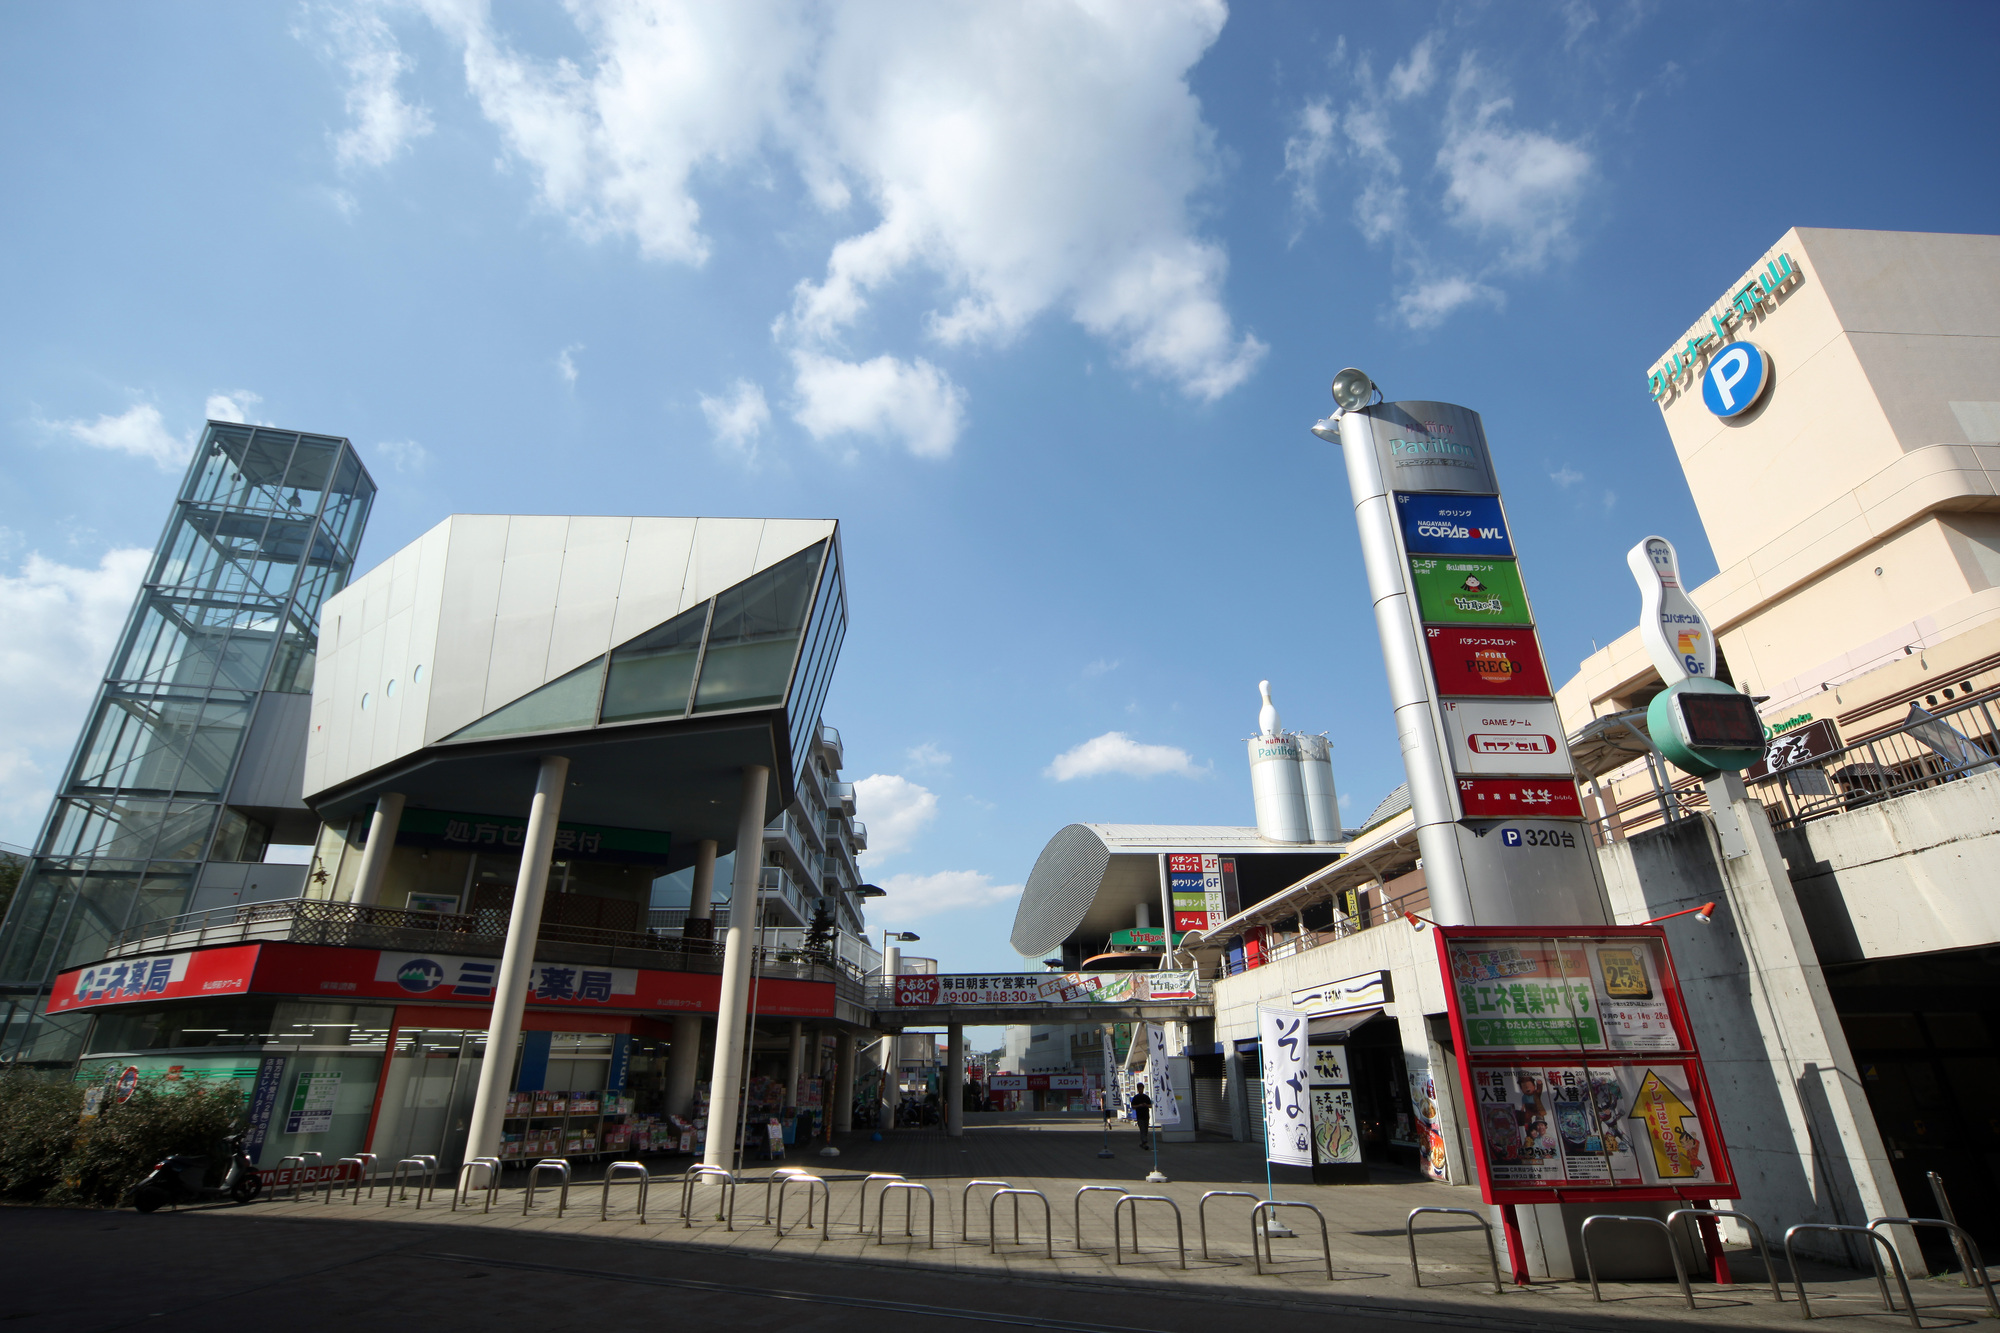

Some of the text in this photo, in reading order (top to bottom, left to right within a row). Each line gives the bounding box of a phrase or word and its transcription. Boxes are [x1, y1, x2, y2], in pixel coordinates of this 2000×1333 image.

[1710, 348, 1750, 411] P
[1389, 436, 1478, 458] Pavilion
[1397, 495, 1410, 504] 6F
[1438, 509, 1472, 517] ボウリング
[1417, 520, 1452, 528] NAGAYAMA
[1445, 563, 1493, 572] 永山健康ランド
[1454, 597, 1502, 612] 竹取の湯
[1427, 628, 1441, 638] 2F
[1459, 638, 1517, 646] パチンコ・スロット
[1465, 659, 1522, 674] PREGO
[1685, 655, 1706, 674] 6F
[1443, 702, 1456, 711] 1F
[1481, 718, 1532, 727] GAME ゲーム
[1772, 712, 1812, 733] Santoku
[1258, 746, 1297, 758] Pavilion
[1459, 780, 1474, 790] 2F
[444, 818, 603, 855] 処方せ受付
[1525, 829, 1576, 849] 320台
[1204, 858, 1218, 869] 2F
[1171, 879, 1204, 887] ボウリング
[1206, 877, 1220, 888] 6F
[1208, 893, 1219, 901] 3F
[1180, 917, 1203, 926] ゲーム
[90, 958, 174, 1001] ミネ薬局
[452, 962, 613, 1002] ミ薬局
[897, 978, 937, 991] 手ぶらで
[942, 976, 1038, 990] 毎日朝まで営業中
[1275, 1018, 1307, 1120] そば
[1313, 1065, 1341, 1079] てんや
[996, 1078, 1021, 1086] パチンコ
[1057, 1078, 1079, 1086] スロット
[1476, 1071, 1504, 1087] 新台
[1547, 1071, 1576, 1087] 新台
[1481, 1087, 1507, 1103] 入替
[1553, 1087, 1580, 1102] 入替
[1647, 1080, 1681, 1175] プレゴはこの先です
